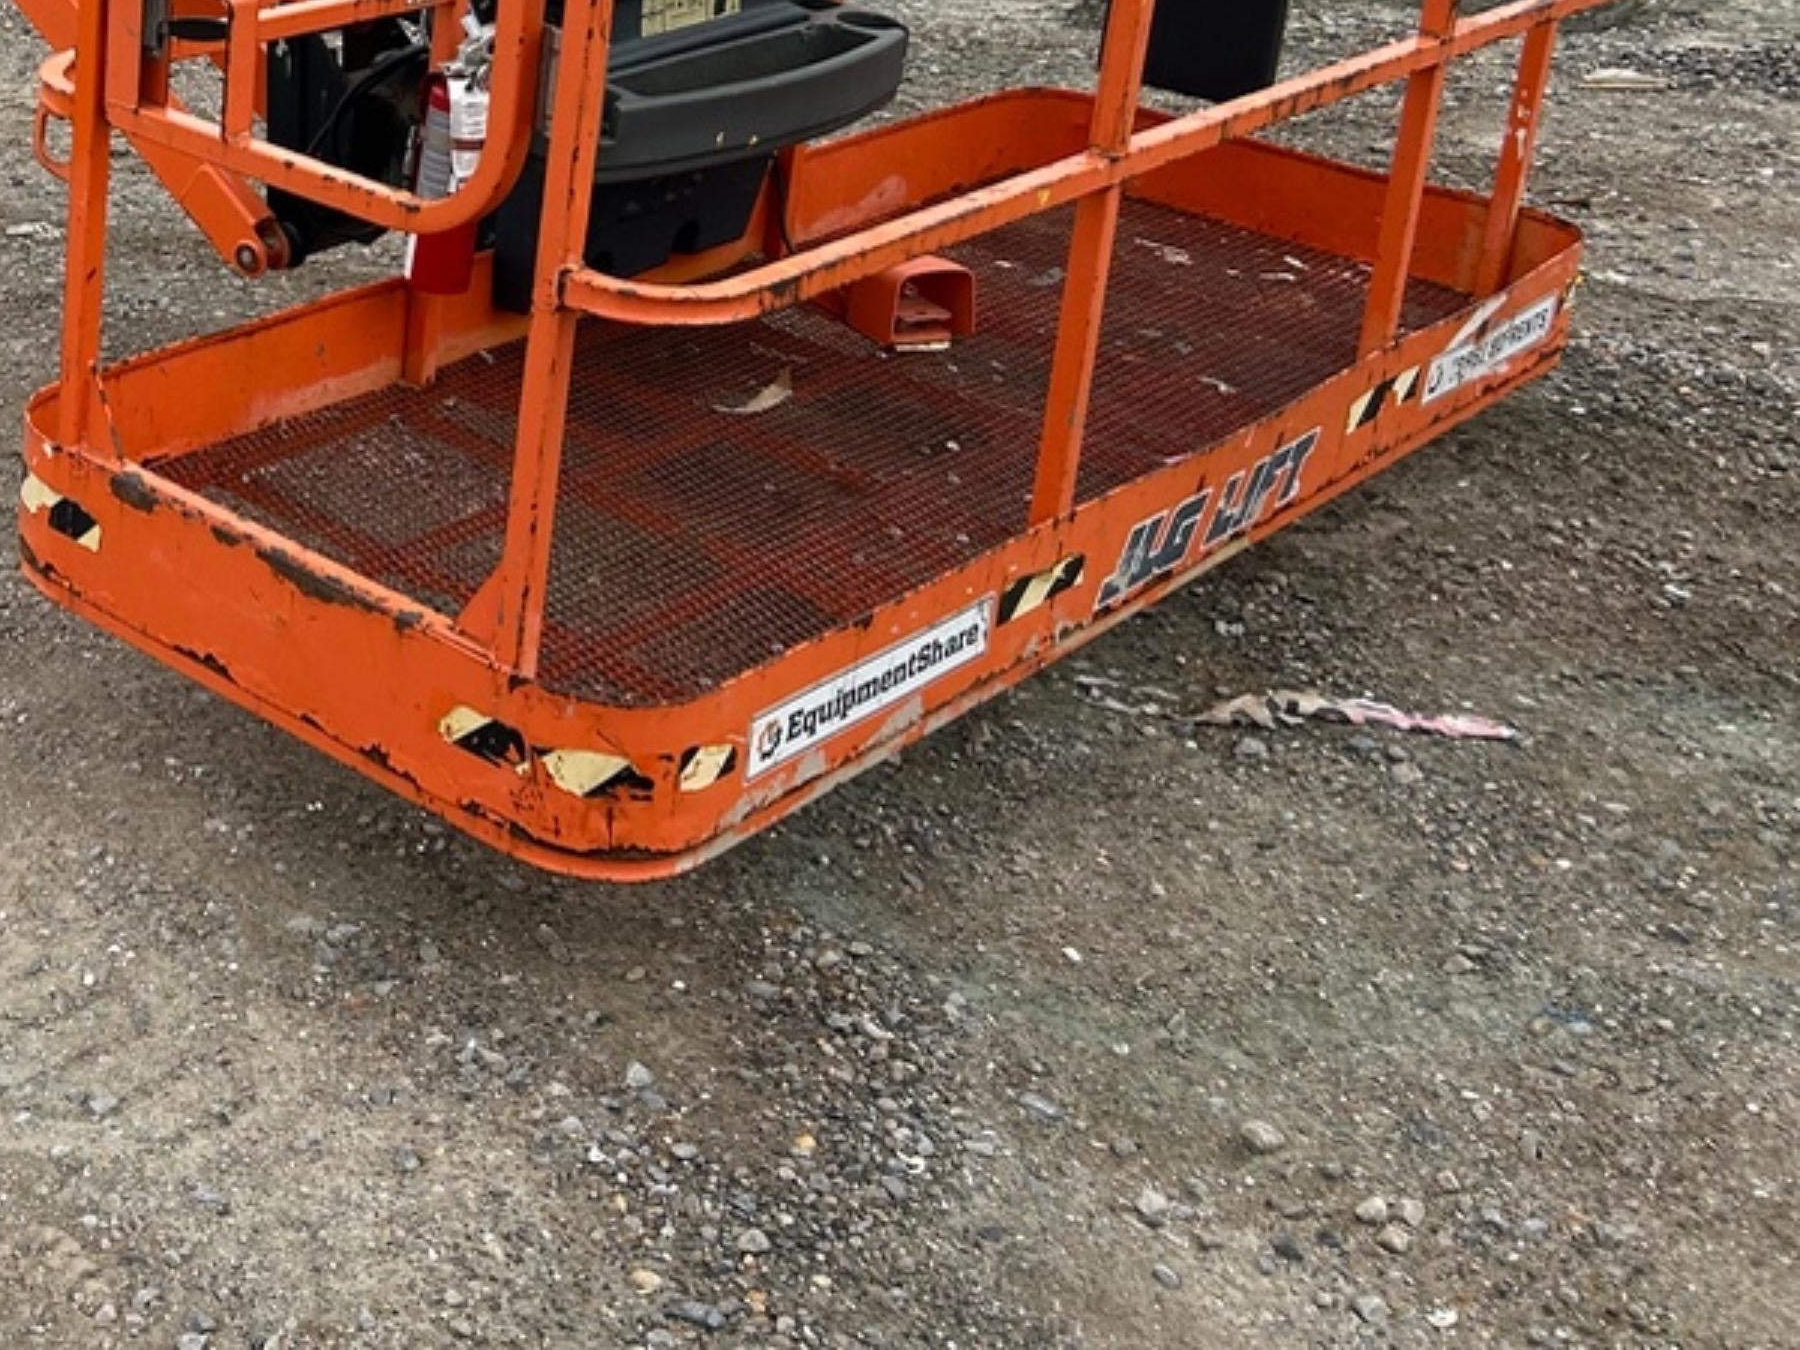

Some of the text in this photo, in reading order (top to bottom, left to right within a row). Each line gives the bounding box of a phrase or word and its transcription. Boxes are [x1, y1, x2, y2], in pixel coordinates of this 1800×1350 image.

[1096, 488, 1212, 607] JLG
[1202, 427, 1321, 549] LIFT
[784, 621, 982, 741] EquipmentShare
